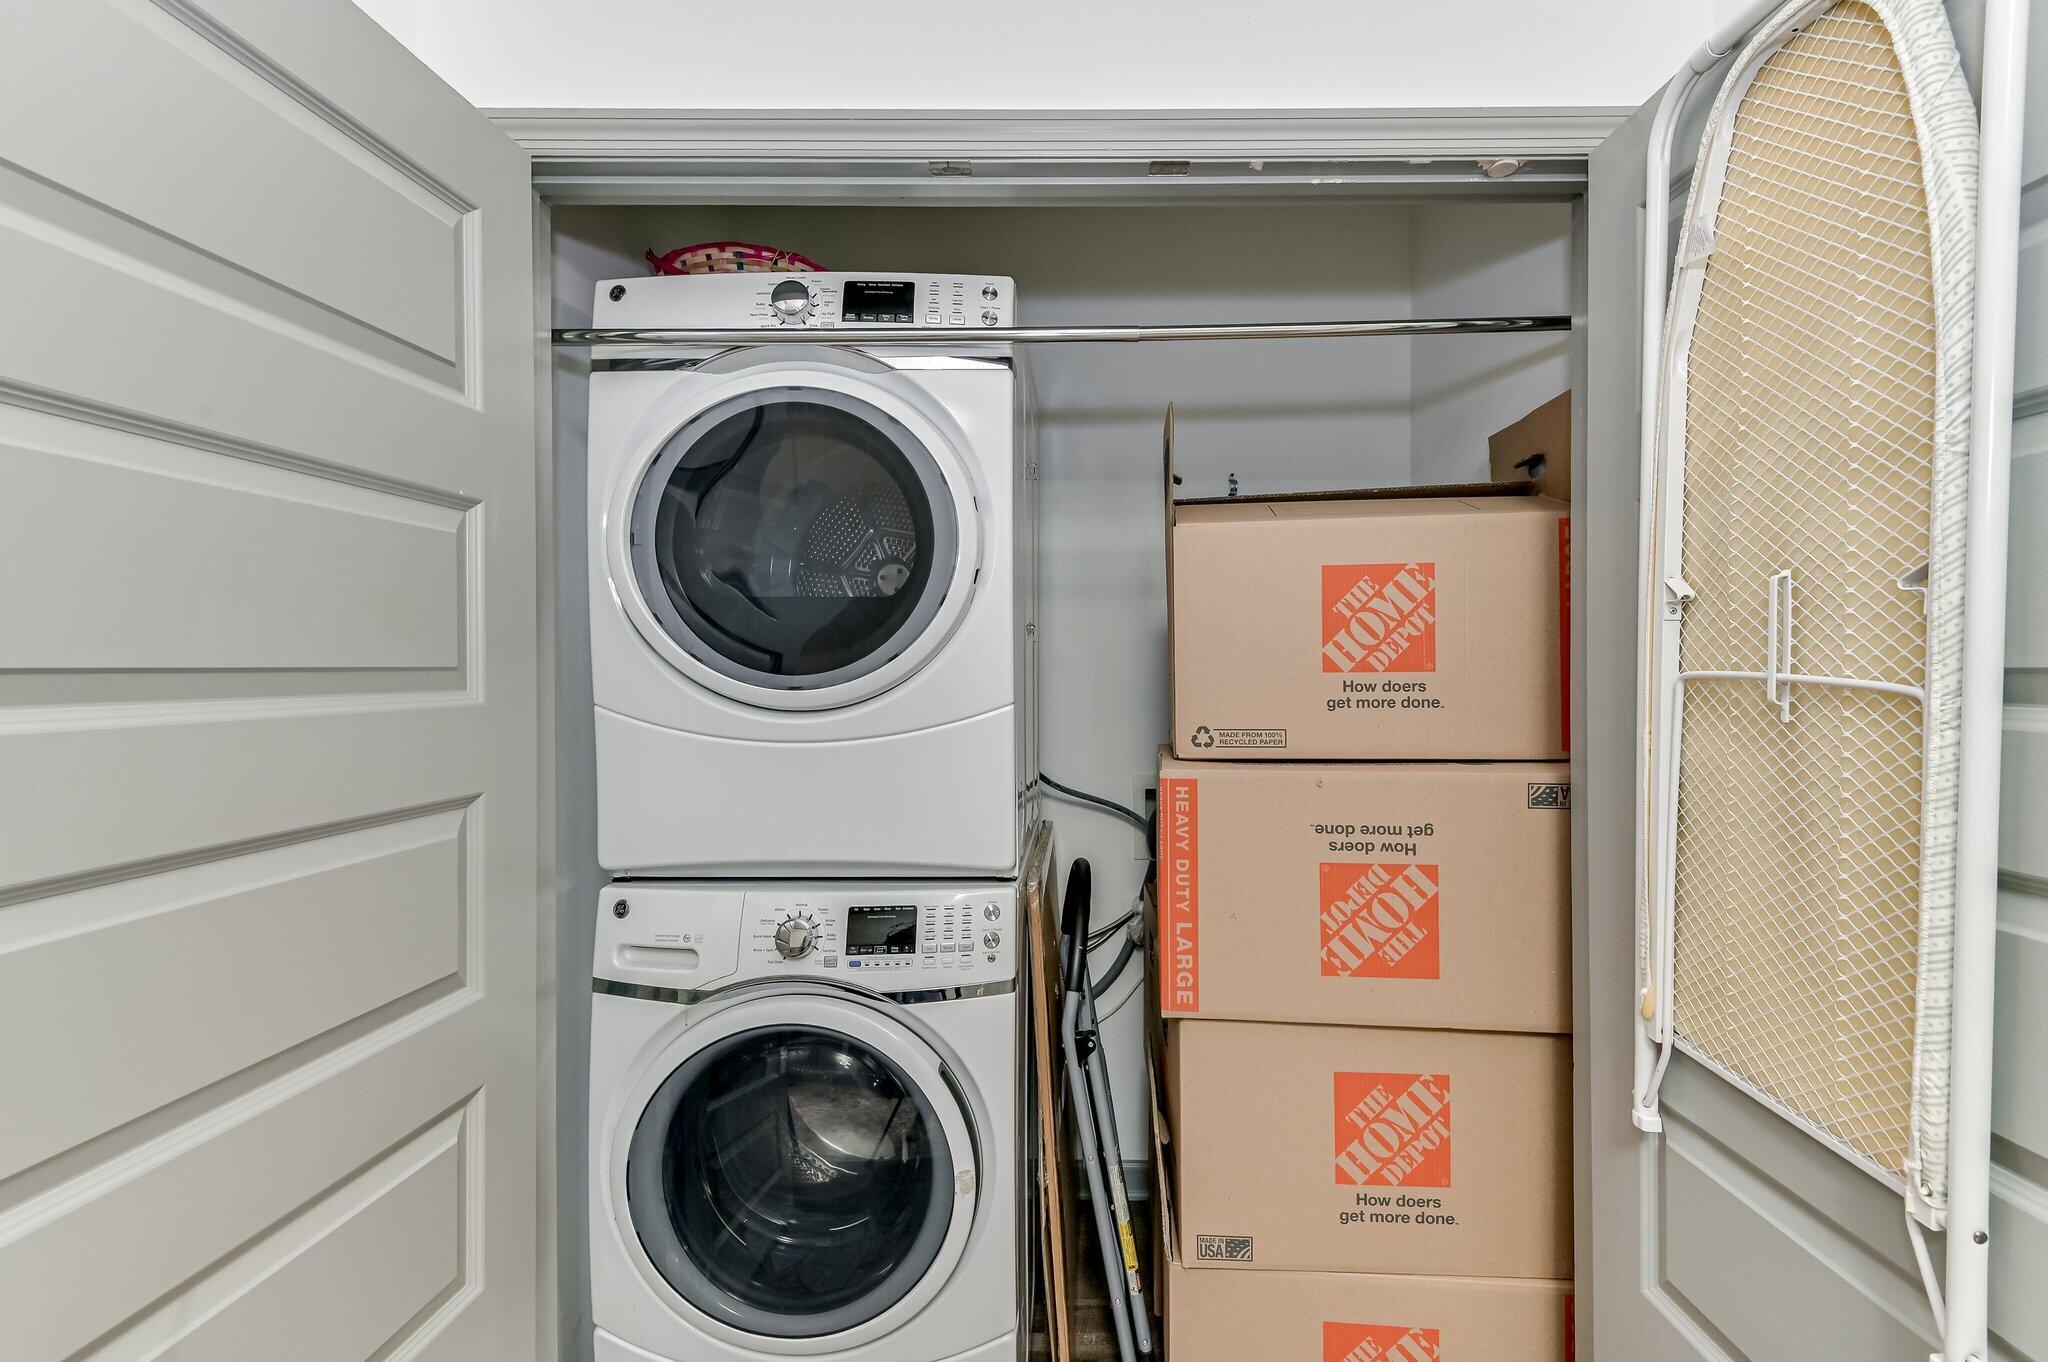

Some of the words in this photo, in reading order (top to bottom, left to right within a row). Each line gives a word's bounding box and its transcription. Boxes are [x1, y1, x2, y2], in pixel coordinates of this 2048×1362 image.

[1322, 560, 1437, 673] HOME
[1332, 575, 1380, 618] THE
[1367, 603, 1436, 673] DEPOT
[1326, 697, 1351, 712] get
[1356, 698, 1397, 710] more
[1343, 680, 1377, 694] How
[1382, 680, 1427, 694] doers
[1175, 786, 1190, 851] HEAVY
[1360, 825, 1403, 836] more
[1407, 823, 1434, 838] get
[1329, 841, 1376, 855] doers
[1380, 842, 1417, 856] How
[1175, 859, 1190, 913] DUTY
[1321, 864, 1391, 935] DEPOT
[1321, 864, 1439, 977] HOME
[1176, 922, 1194, 1005] LARGE
[1378, 923, 1428, 967] THE
[1336, 1073, 1451, 1185] HOME
[1345, 1084, 1394, 1131] THE
[1379, 1116, 1451, 1186] DEPOT
[1339, 1211, 1365, 1225] get
[1370, 1212, 1410, 1224] more
[1356, 1193, 1391, 1207] How
[1396, 1194, 1441, 1208] doers
[1200, 1244, 1224, 1258] USA
